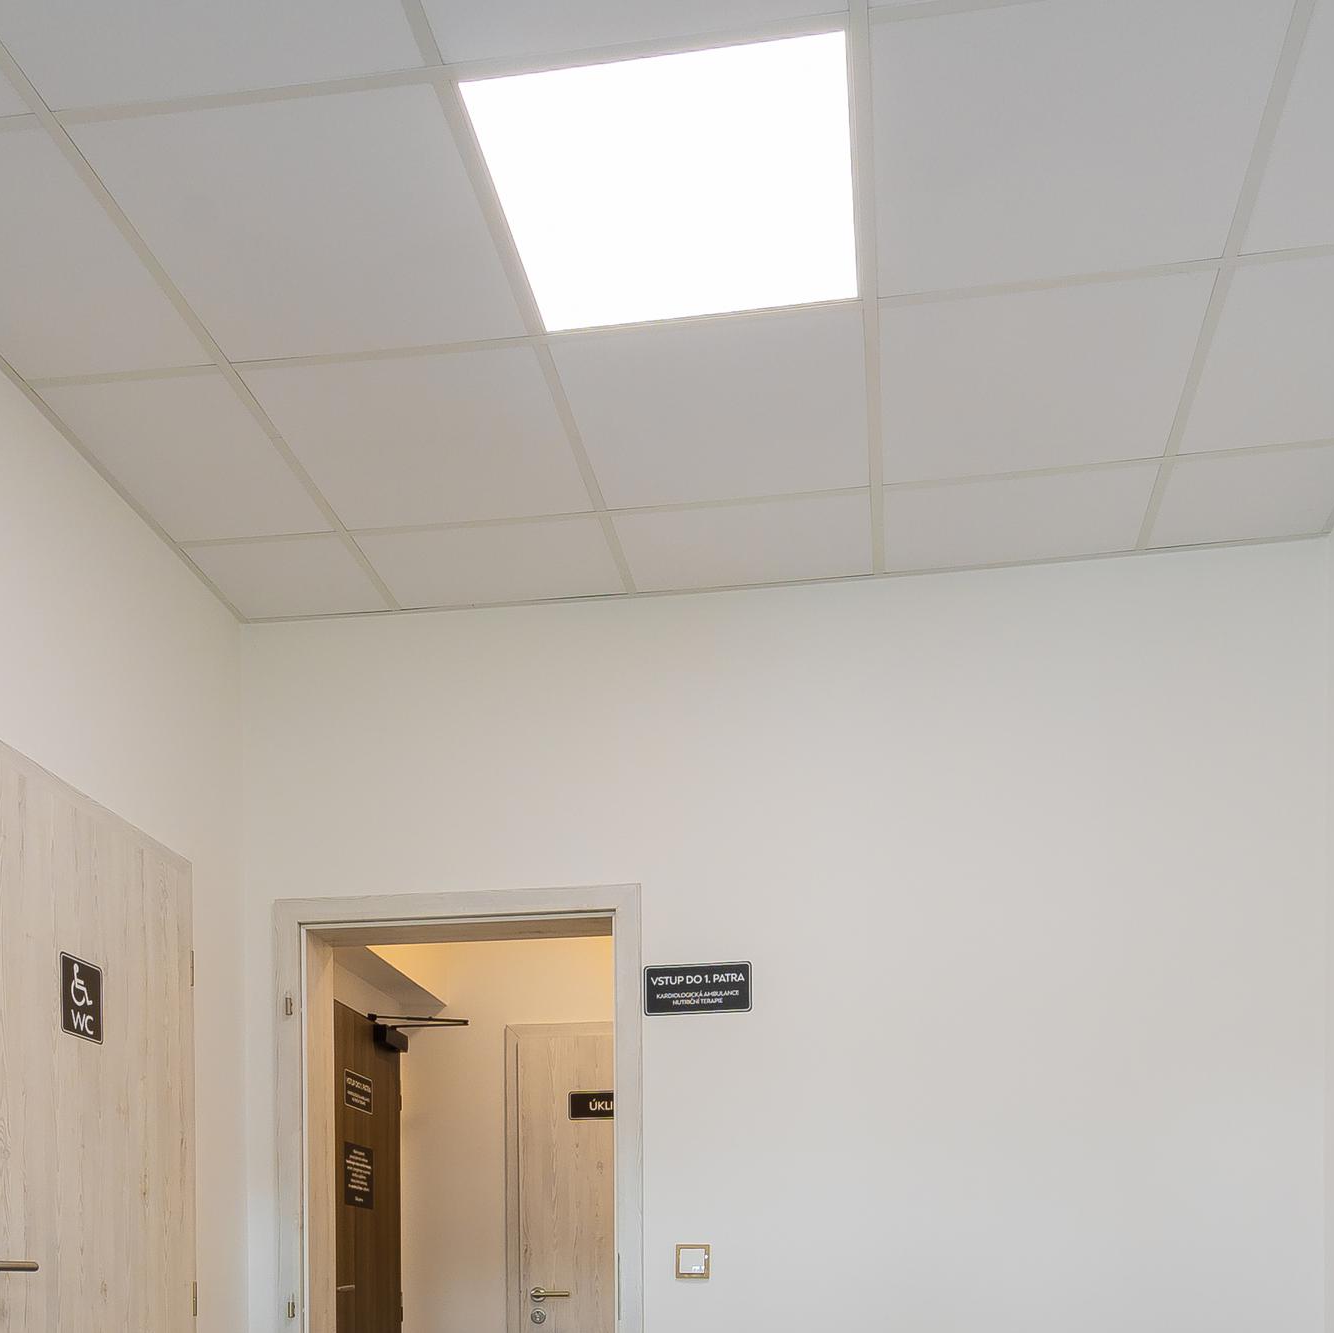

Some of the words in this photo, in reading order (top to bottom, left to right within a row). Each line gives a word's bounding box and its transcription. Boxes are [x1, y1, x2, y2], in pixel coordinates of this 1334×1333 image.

[651, 975, 685, 986] VSTUP
[686, 974, 703, 985] DO
[704, 974, 711, 984] 1.
[712, 972, 746, 983] PATRA
[656, 990, 704, 1000] KARDIOLOGICKÁ
[704, 989, 740, 998] AMBULANCE
[71, 1009, 94, 1035] WC
[589, 1098, 614, 1111] ÚKLI
